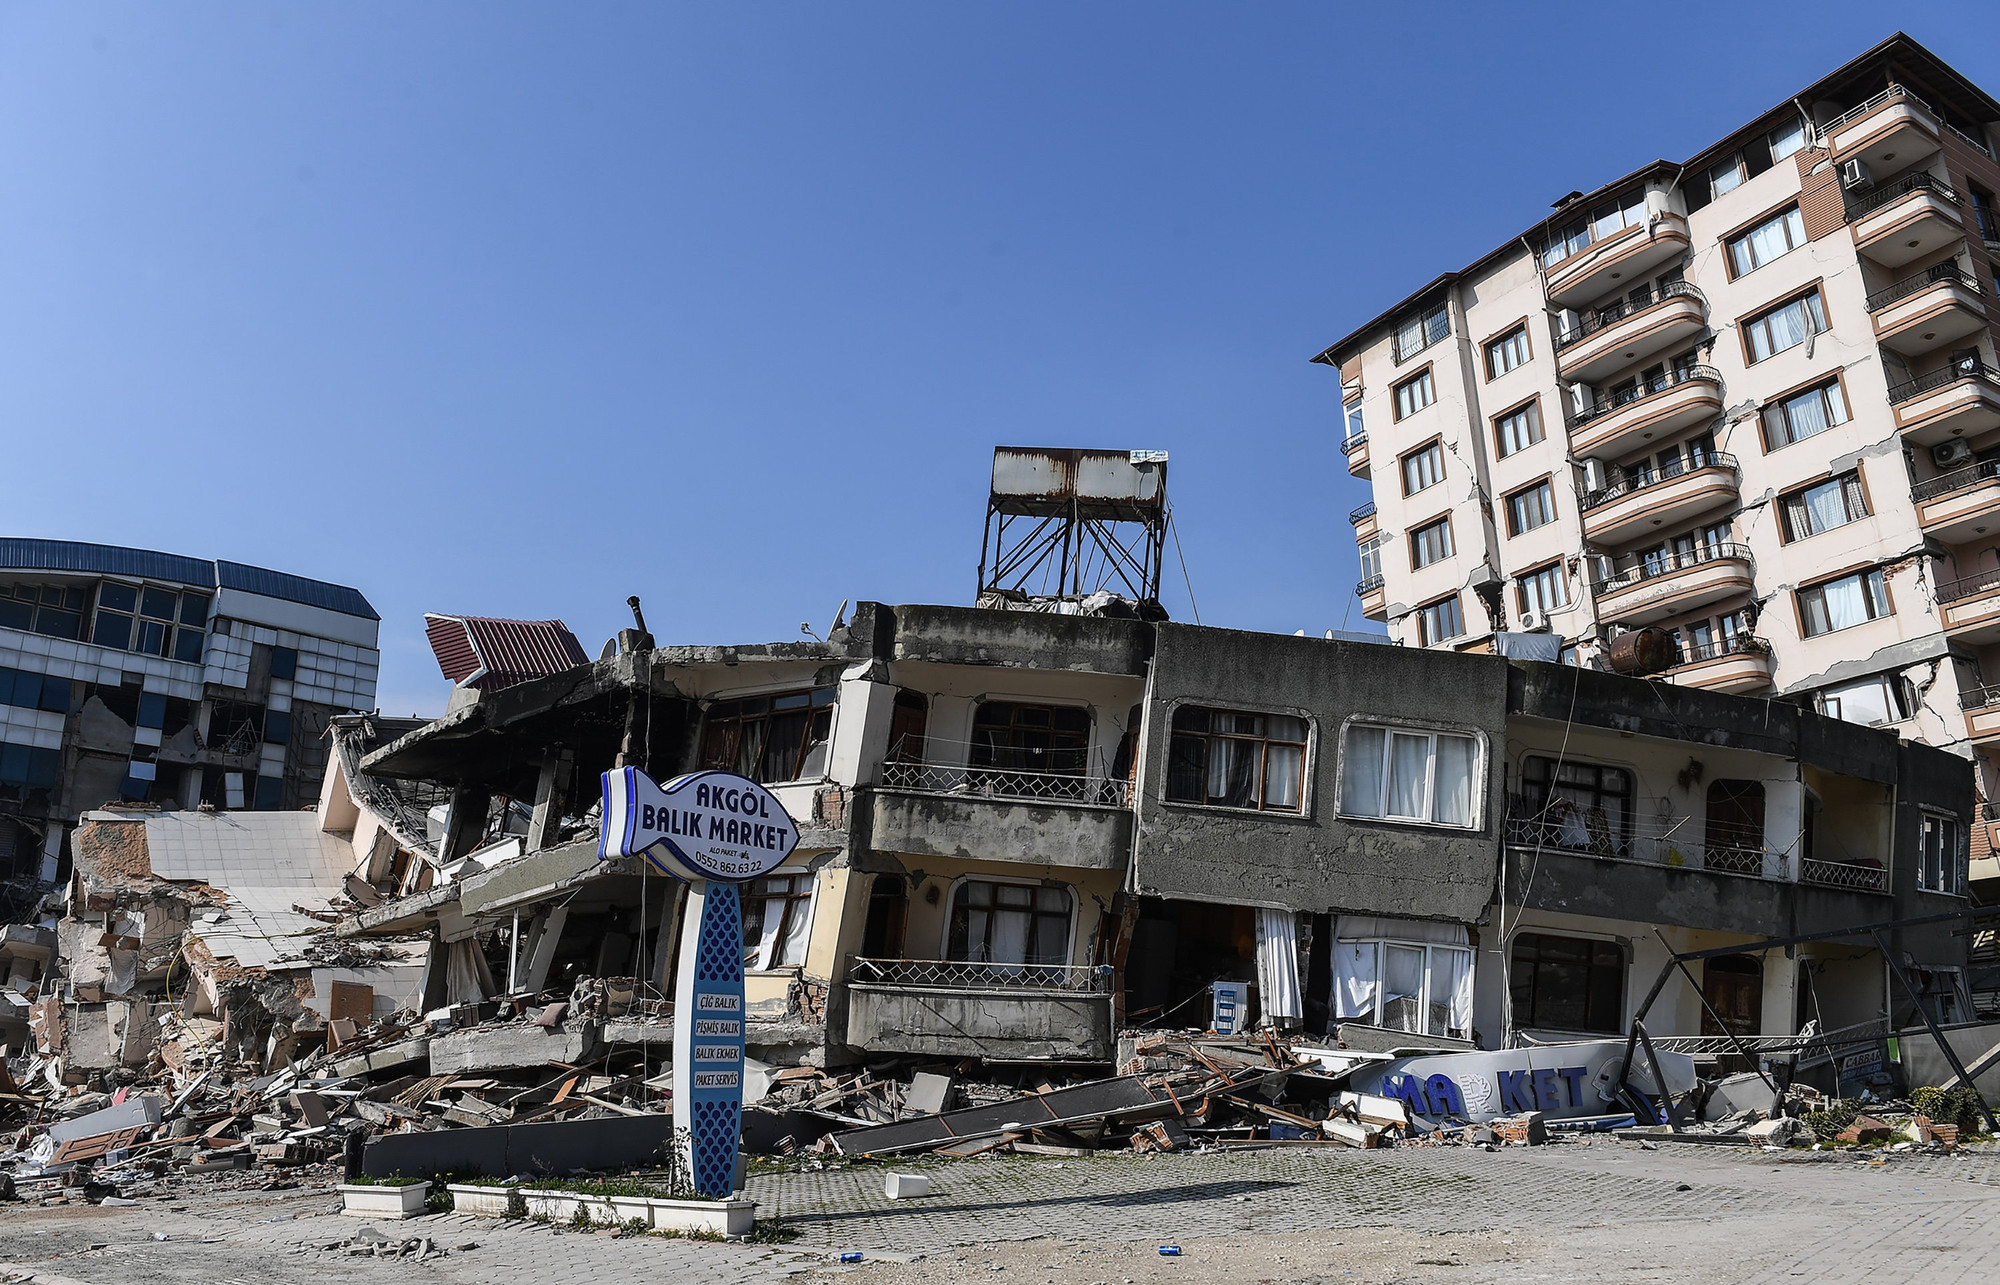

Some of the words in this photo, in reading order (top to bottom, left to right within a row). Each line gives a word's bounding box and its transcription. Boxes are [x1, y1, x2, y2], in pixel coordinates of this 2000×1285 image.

[696, 782, 769, 819] AKGÖL
[642, 803, 703, 839] BALIK
[708, 815, 788, 852] MARKET
[709, 846, 721, 855] ALO
[721, 848, 738, 857] PAKET
[695, 850, 718, 870] 0552
[720, 861, 737, 874] 862
[738, 862, 750, 874] 63
[750, 860, 762, 873] 22
[714, 997, 738, 1009] BALIK
[720, 1022, 739, 1034] BALIK
[695, 1047, 716, 1059] BALIK
[716, 1048, 739, 1060] EKMEK
[695, 1074, 715, 1086] PAKET
[716, 1071, 738, 1086] SERVİS
[1381, 1066, 1588, 1117] MARKET
